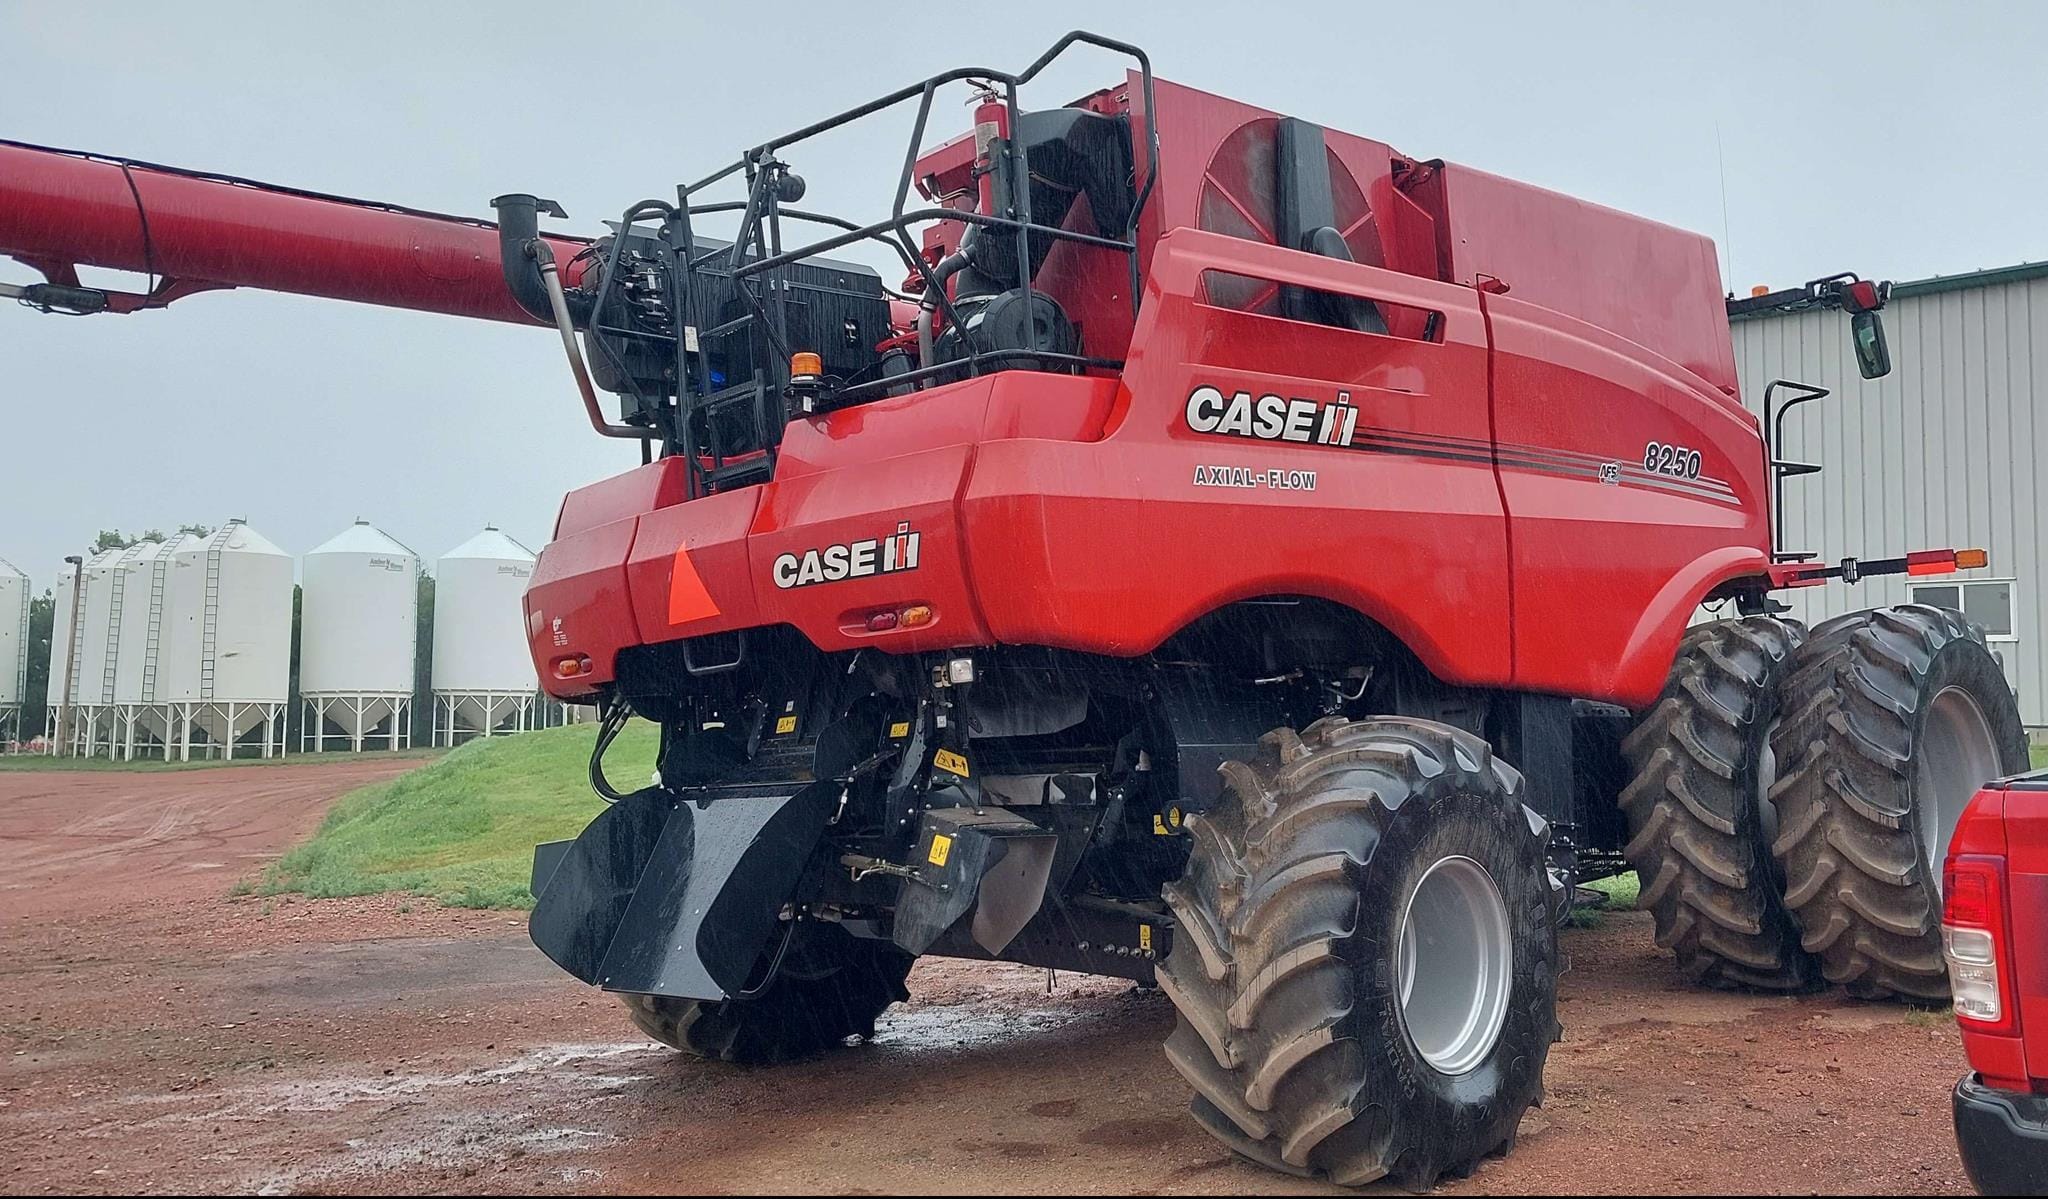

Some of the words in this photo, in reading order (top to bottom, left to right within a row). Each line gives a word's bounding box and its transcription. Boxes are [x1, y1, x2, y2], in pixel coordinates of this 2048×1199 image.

[1186, 386, 1318, 442] CASE
[1193, 465, 1317, 491] AXIAL-FLOW
[1599, 463, 1618, 479] AFS
[1644, 441, 1702, 480] 8250
[772, 539, 877, 589] CASE
